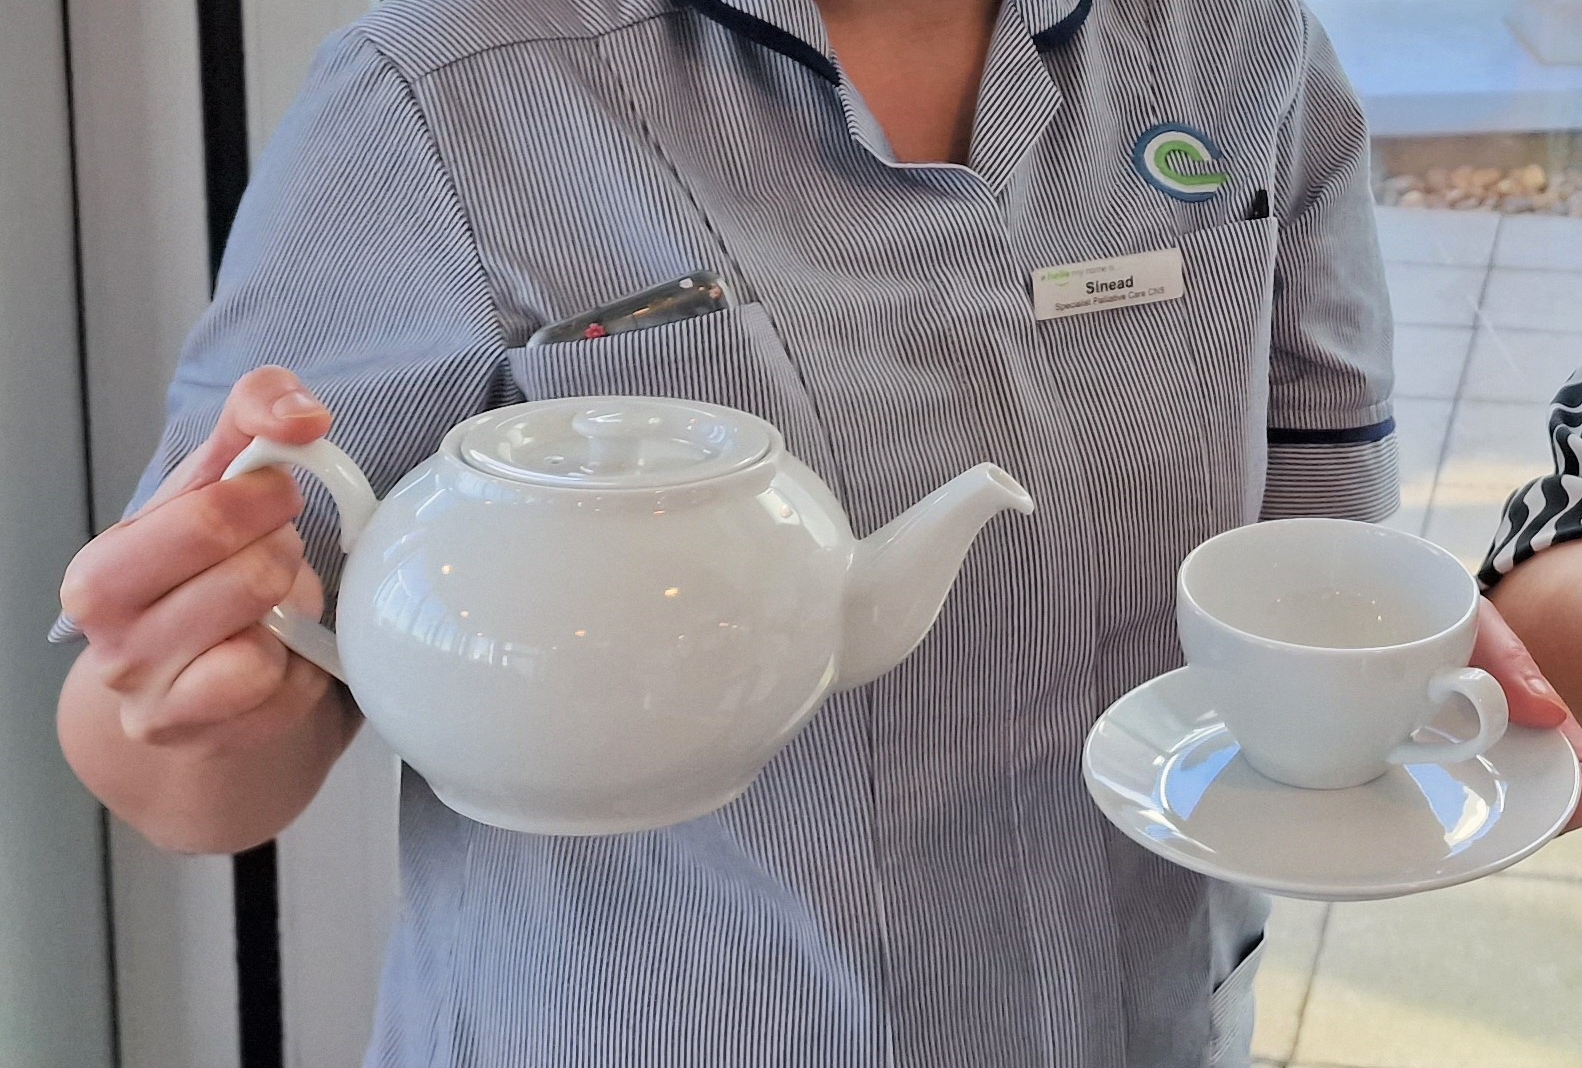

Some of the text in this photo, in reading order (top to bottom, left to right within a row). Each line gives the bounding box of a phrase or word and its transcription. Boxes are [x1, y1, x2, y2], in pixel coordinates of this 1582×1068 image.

[1086, 275, 1134, 294] Sinead
[1055, 297, 1091, 311] Specialist
[1093, 293, 1126, 305] Palliative
[1128, 290, 1146, 299] Care
